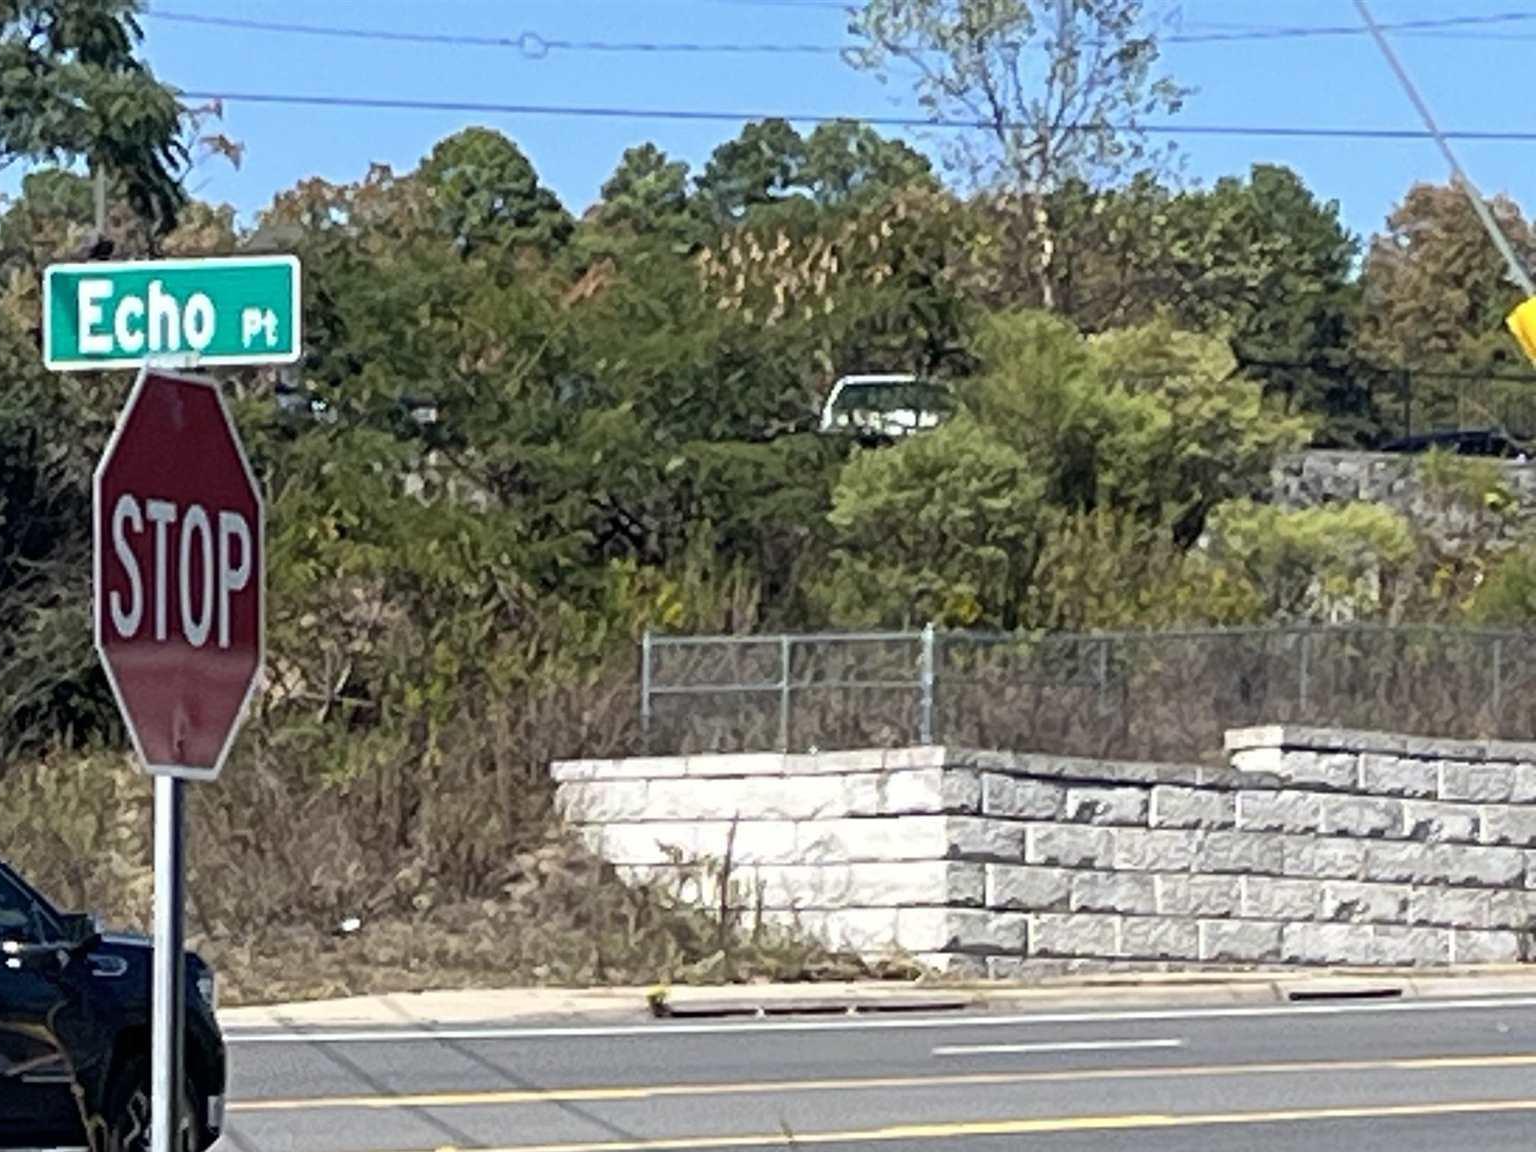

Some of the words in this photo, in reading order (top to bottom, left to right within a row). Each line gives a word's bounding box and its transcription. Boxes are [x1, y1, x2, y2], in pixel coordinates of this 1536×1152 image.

[77, 279, 215, 353] Echo
[241, 306, 279, 348] Pt
[109, 494, 252, 648] STOP
